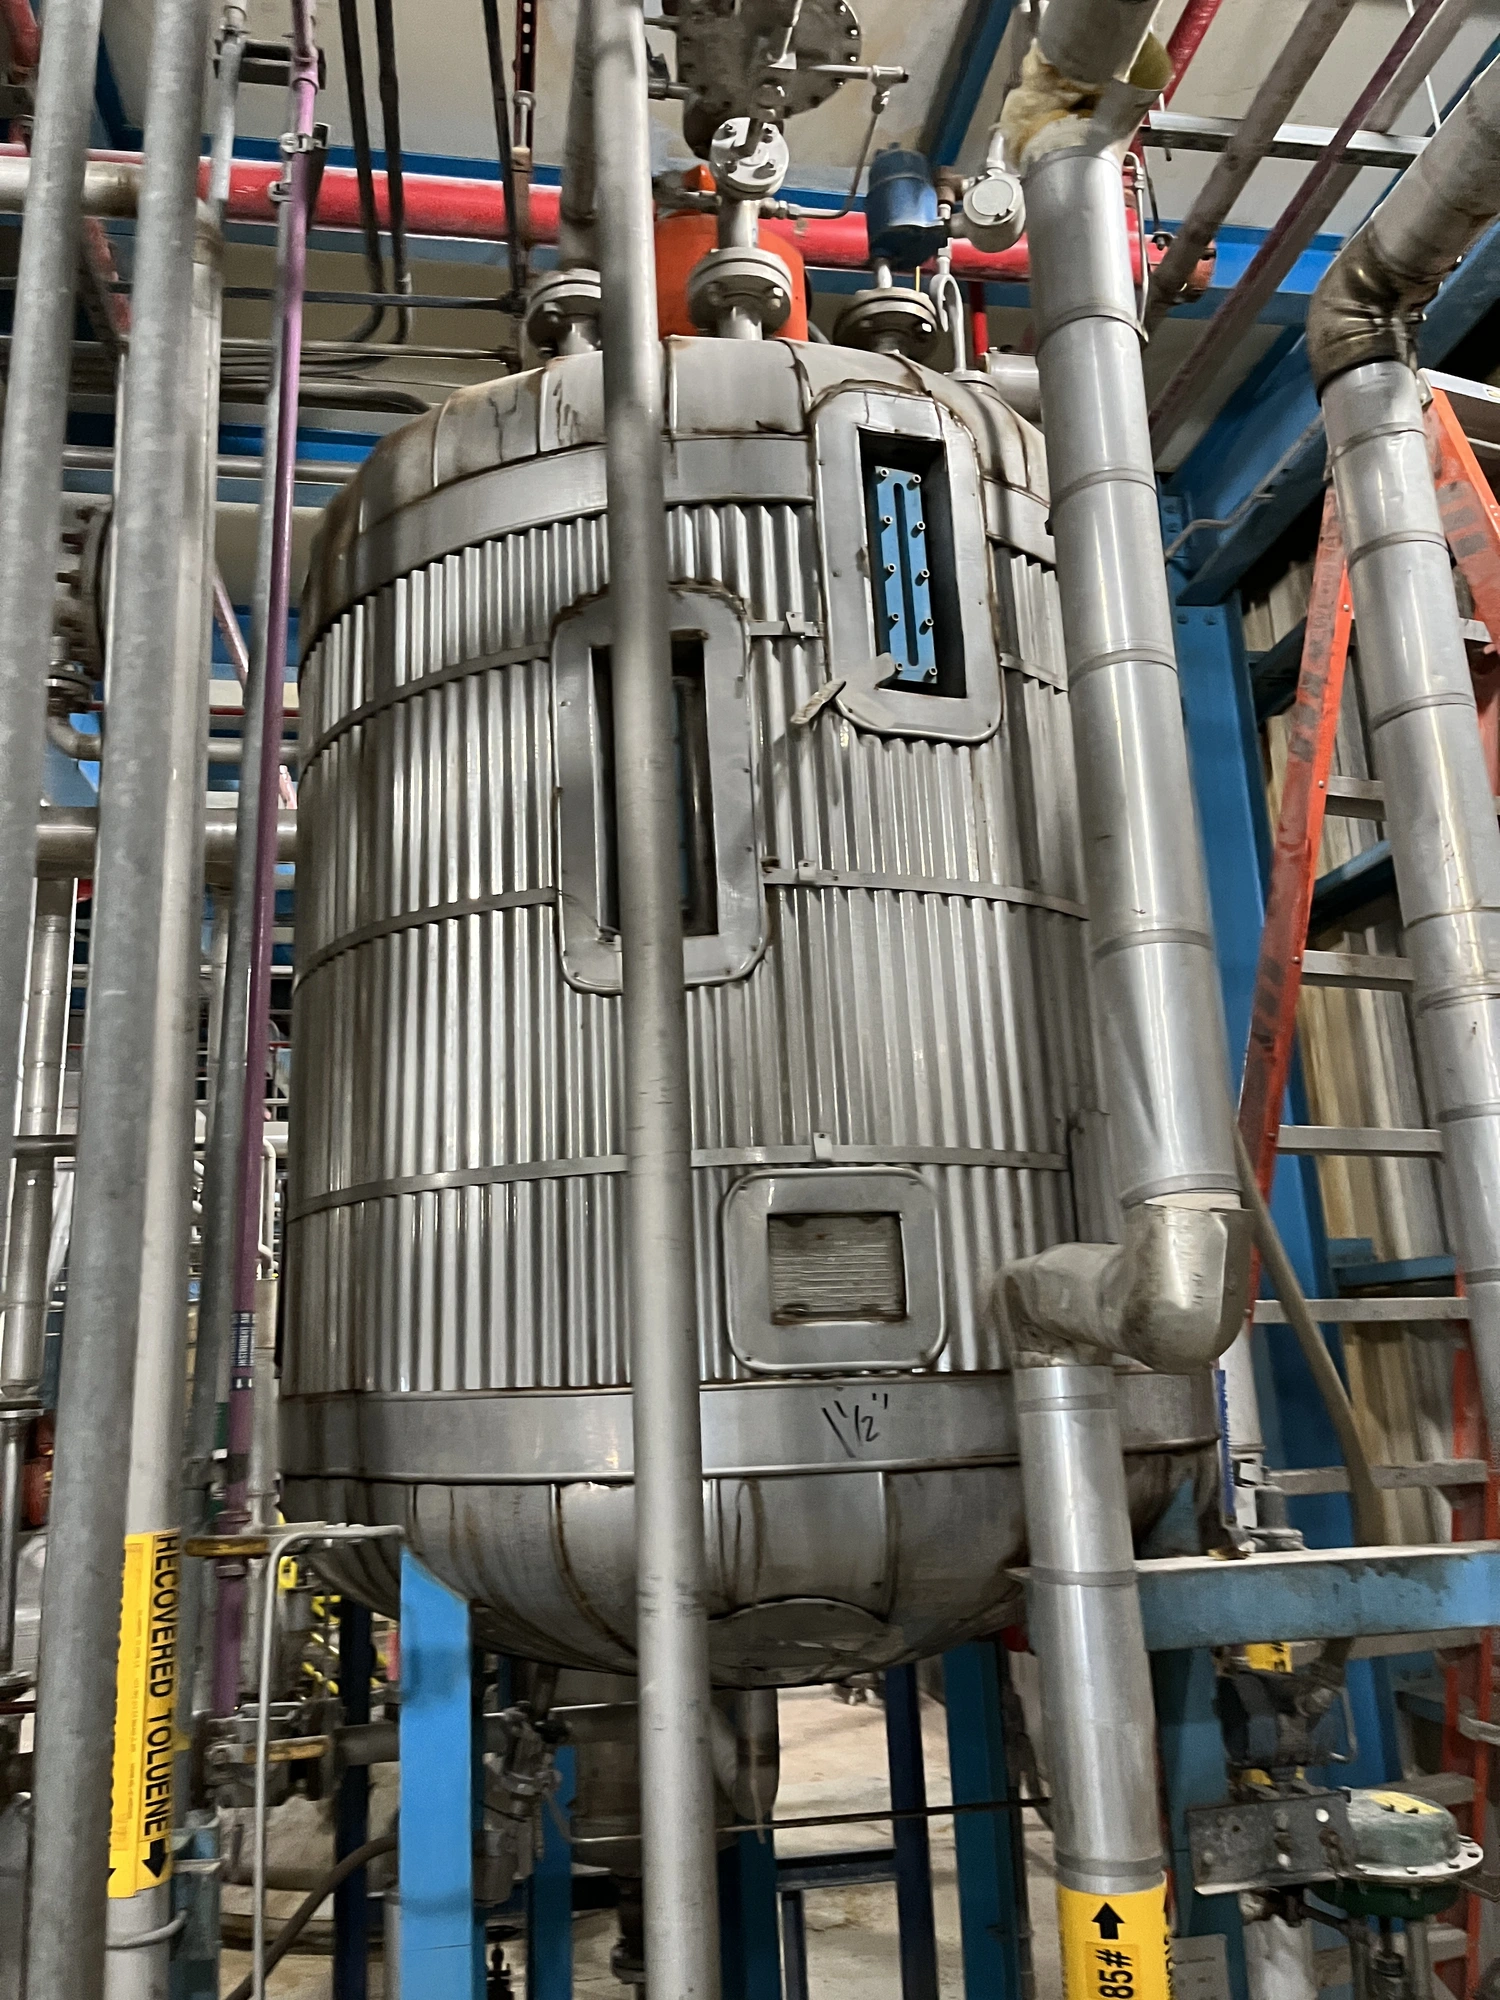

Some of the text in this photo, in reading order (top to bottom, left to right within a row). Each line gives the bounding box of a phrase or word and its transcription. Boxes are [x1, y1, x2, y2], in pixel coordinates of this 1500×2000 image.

[144, 1535, 181, 1837] RECOVERED TOLUENE
[1095, 1948, 1134, 1999] 85#
